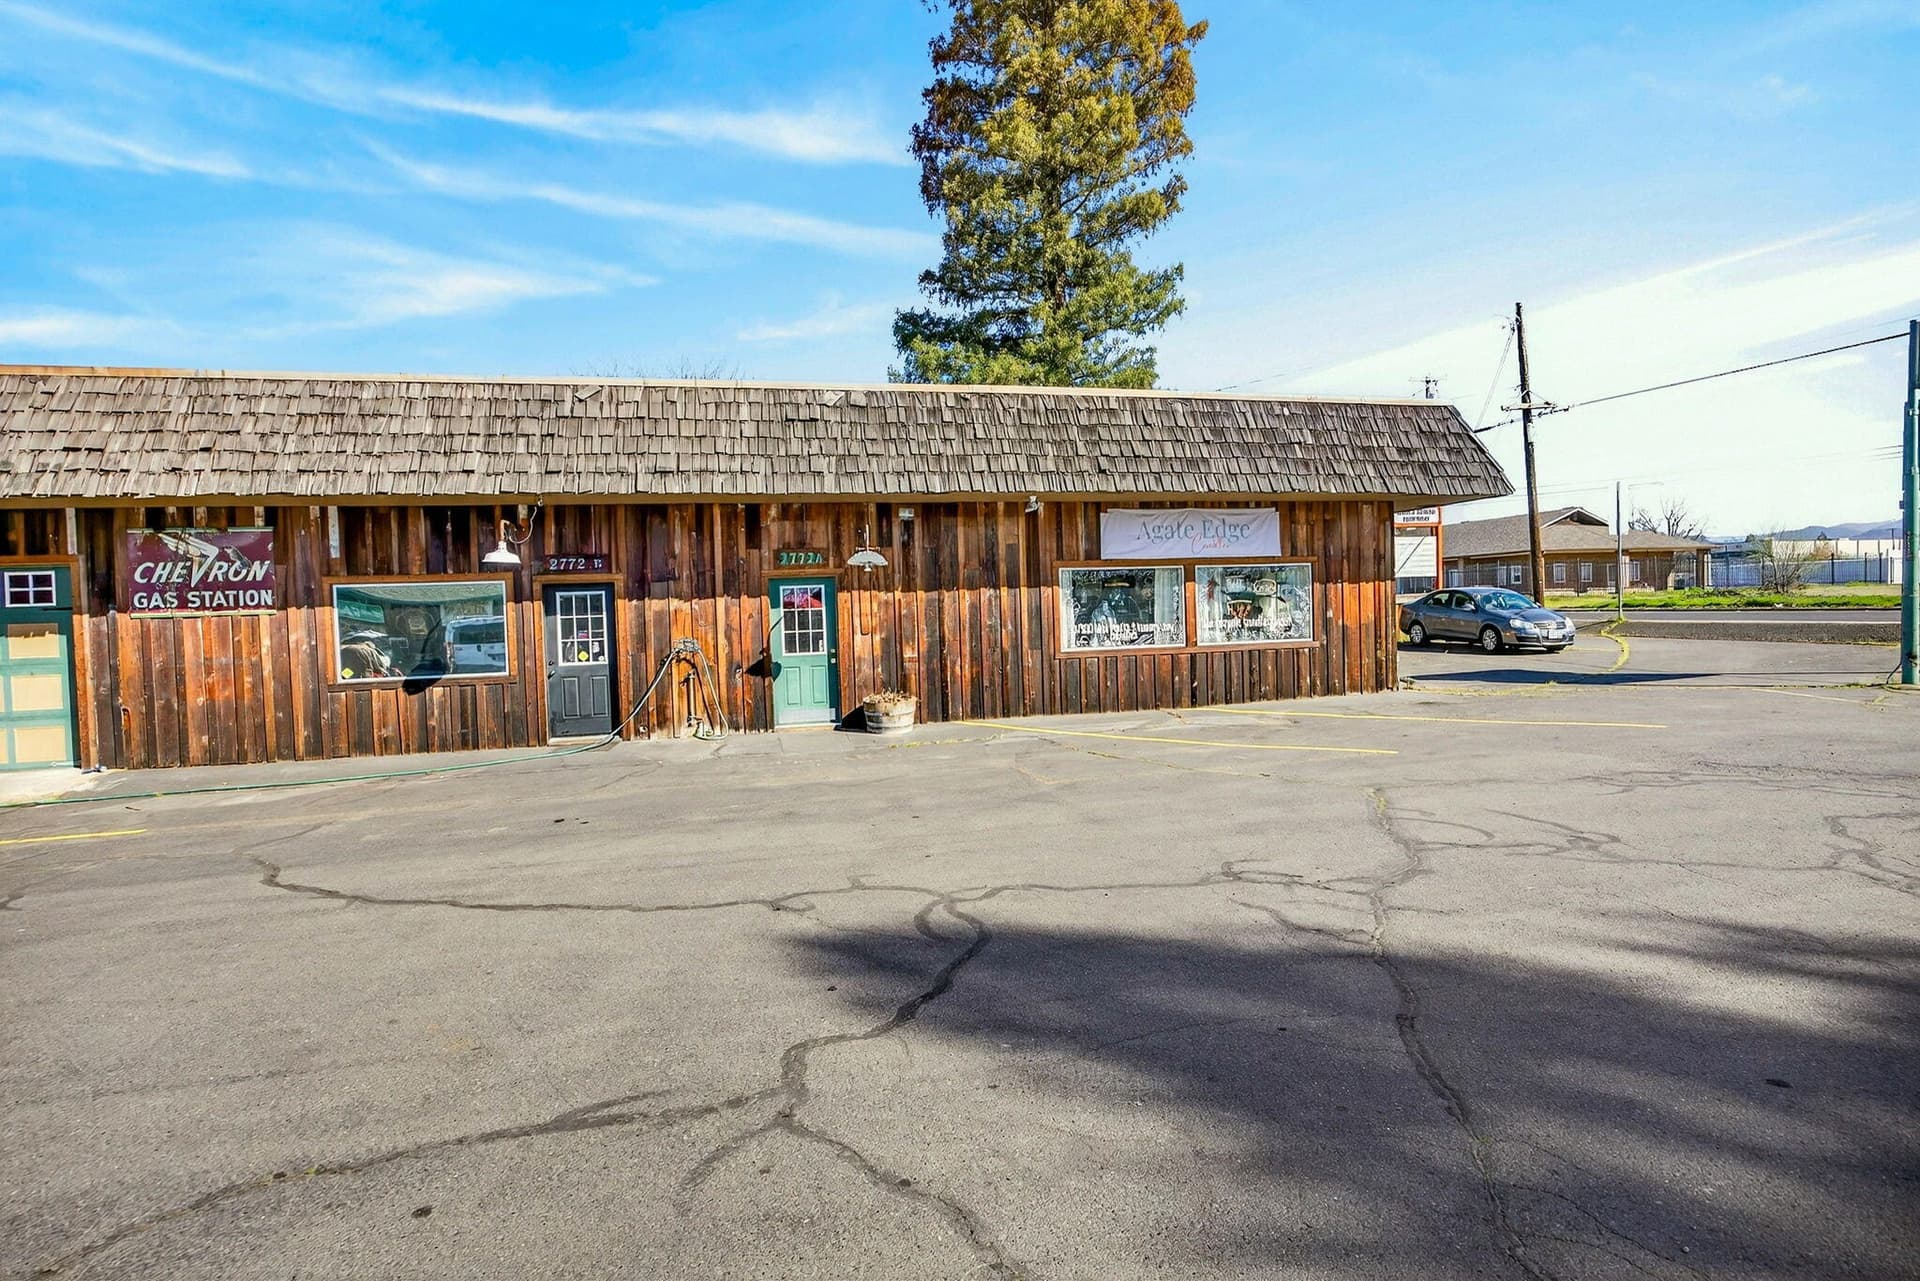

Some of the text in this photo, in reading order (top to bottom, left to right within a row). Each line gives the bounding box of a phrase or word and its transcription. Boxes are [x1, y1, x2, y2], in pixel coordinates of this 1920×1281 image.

[1136, 518, 1250, 544] Agate Edge
[134, 559, 270, 587] CHEVRON
[549, 558, 585, 570] 2772
[133, 590, 273, 609] GAS STATION
